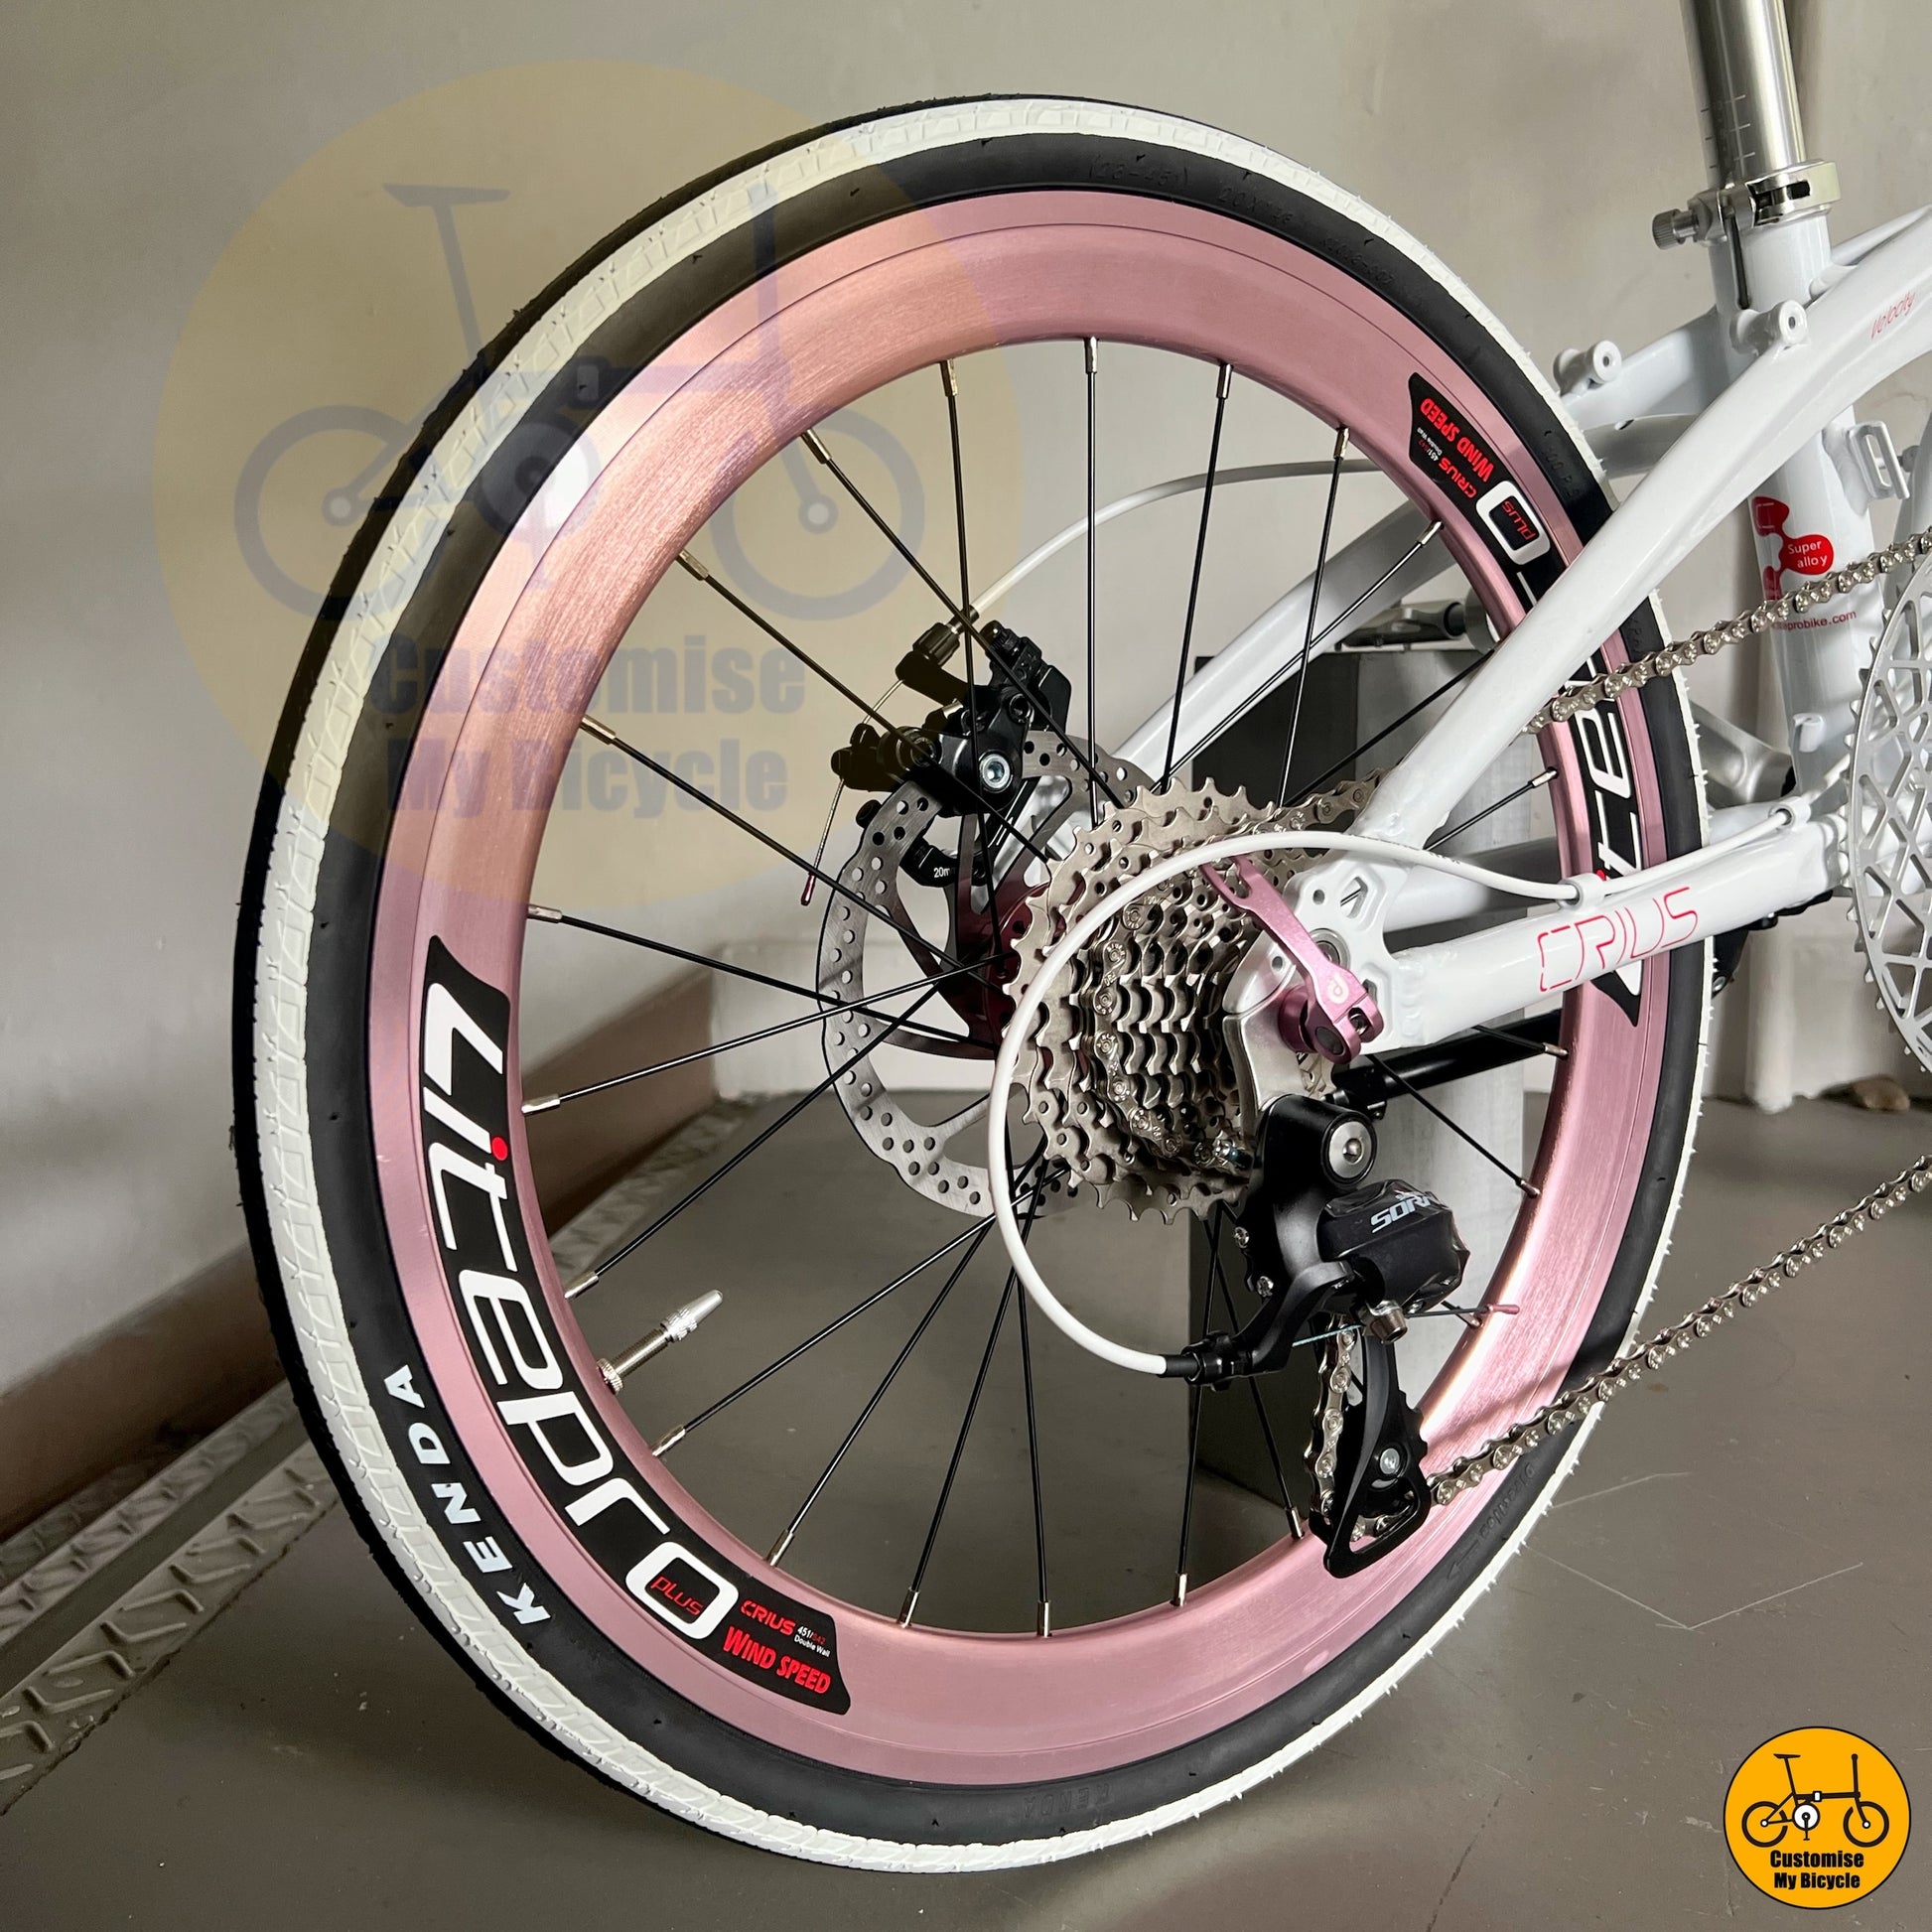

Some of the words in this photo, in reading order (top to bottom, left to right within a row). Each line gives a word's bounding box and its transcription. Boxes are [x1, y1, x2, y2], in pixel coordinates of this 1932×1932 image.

[1420, 398, 1460, 442] SPEED
[1439, 458, 1477, 498] CRIUS
[1456, 437, 1494, 483] WIND
[1788, 540, 1822, 557] Super
[1797, 554, 1828, 569] alloy
[1538, 886, 1699, 993] CRIUS
[385, 1364, 552, 1626] KENDA
[741, 1598, 796, 1637] CRIUS
[723, 1625, 777, 1676] WIND
[776, 1646, 831, 1695] SPEED
[794, 1634, 816, 1650] Double
[816, 1646, 831, 1658] Wall
